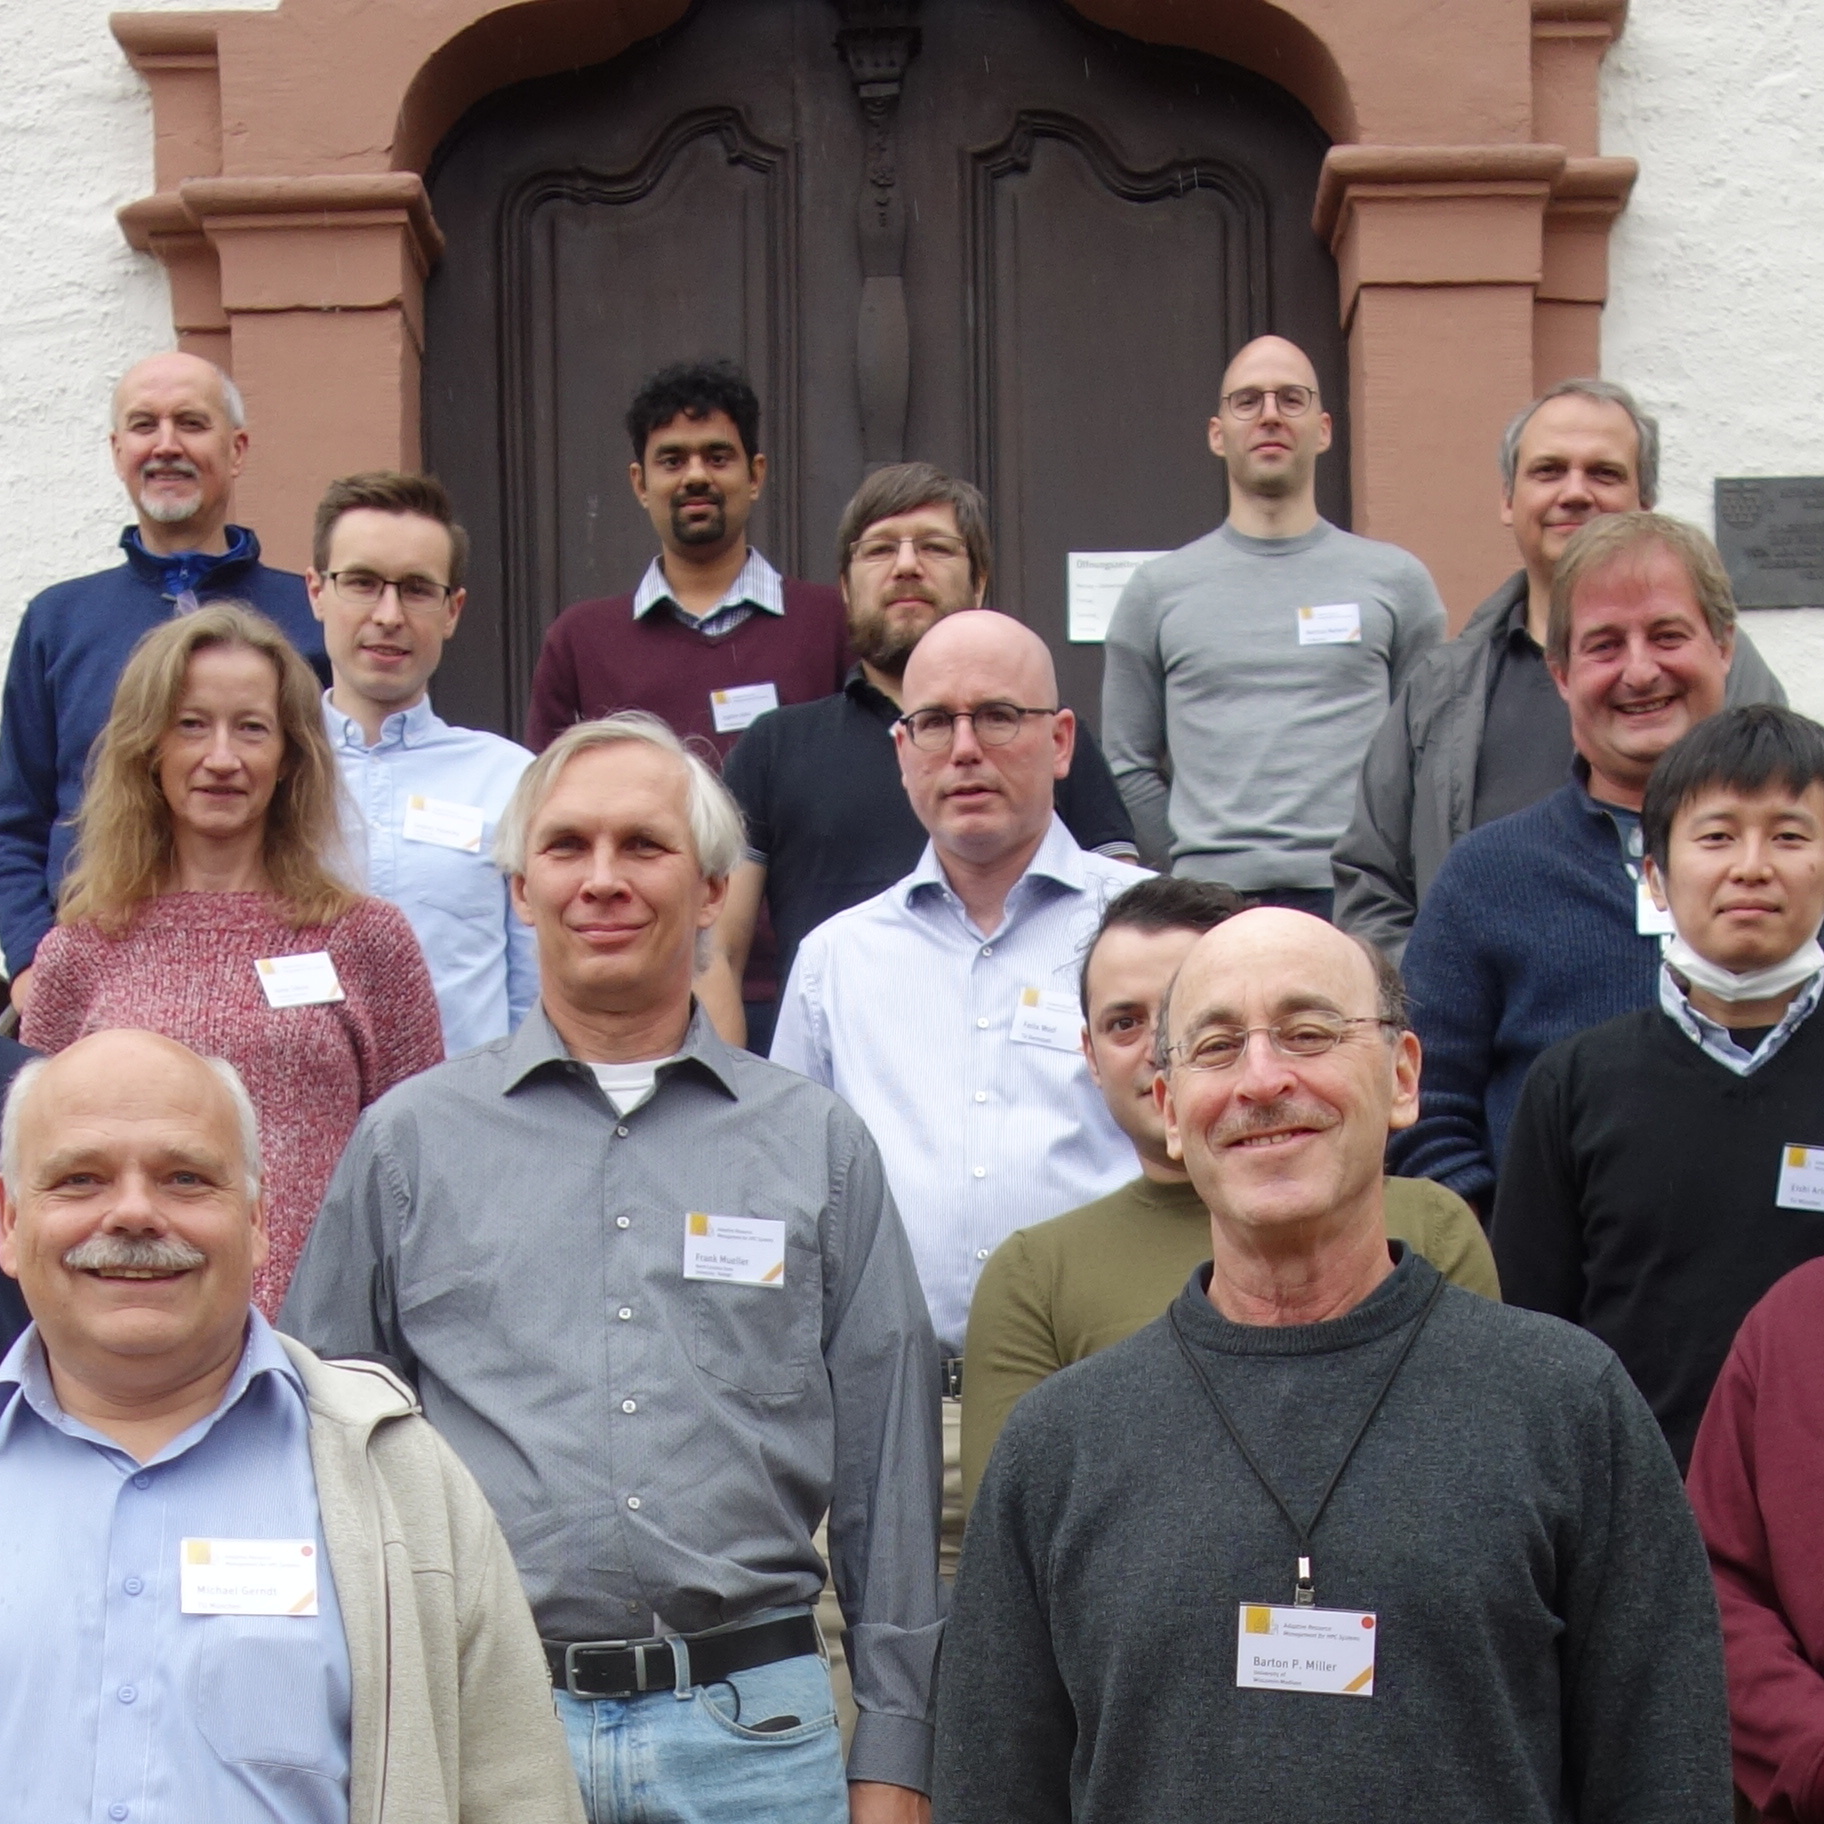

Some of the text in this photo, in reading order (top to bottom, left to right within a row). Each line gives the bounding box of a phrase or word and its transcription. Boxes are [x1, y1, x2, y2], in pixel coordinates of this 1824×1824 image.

[695, 1252, 749, 1266] Frank Mueller
[197, 1585, 277, 1596] Michael Gerndt
[1253, 1656, 1337, 1671] Barton P. Miller
